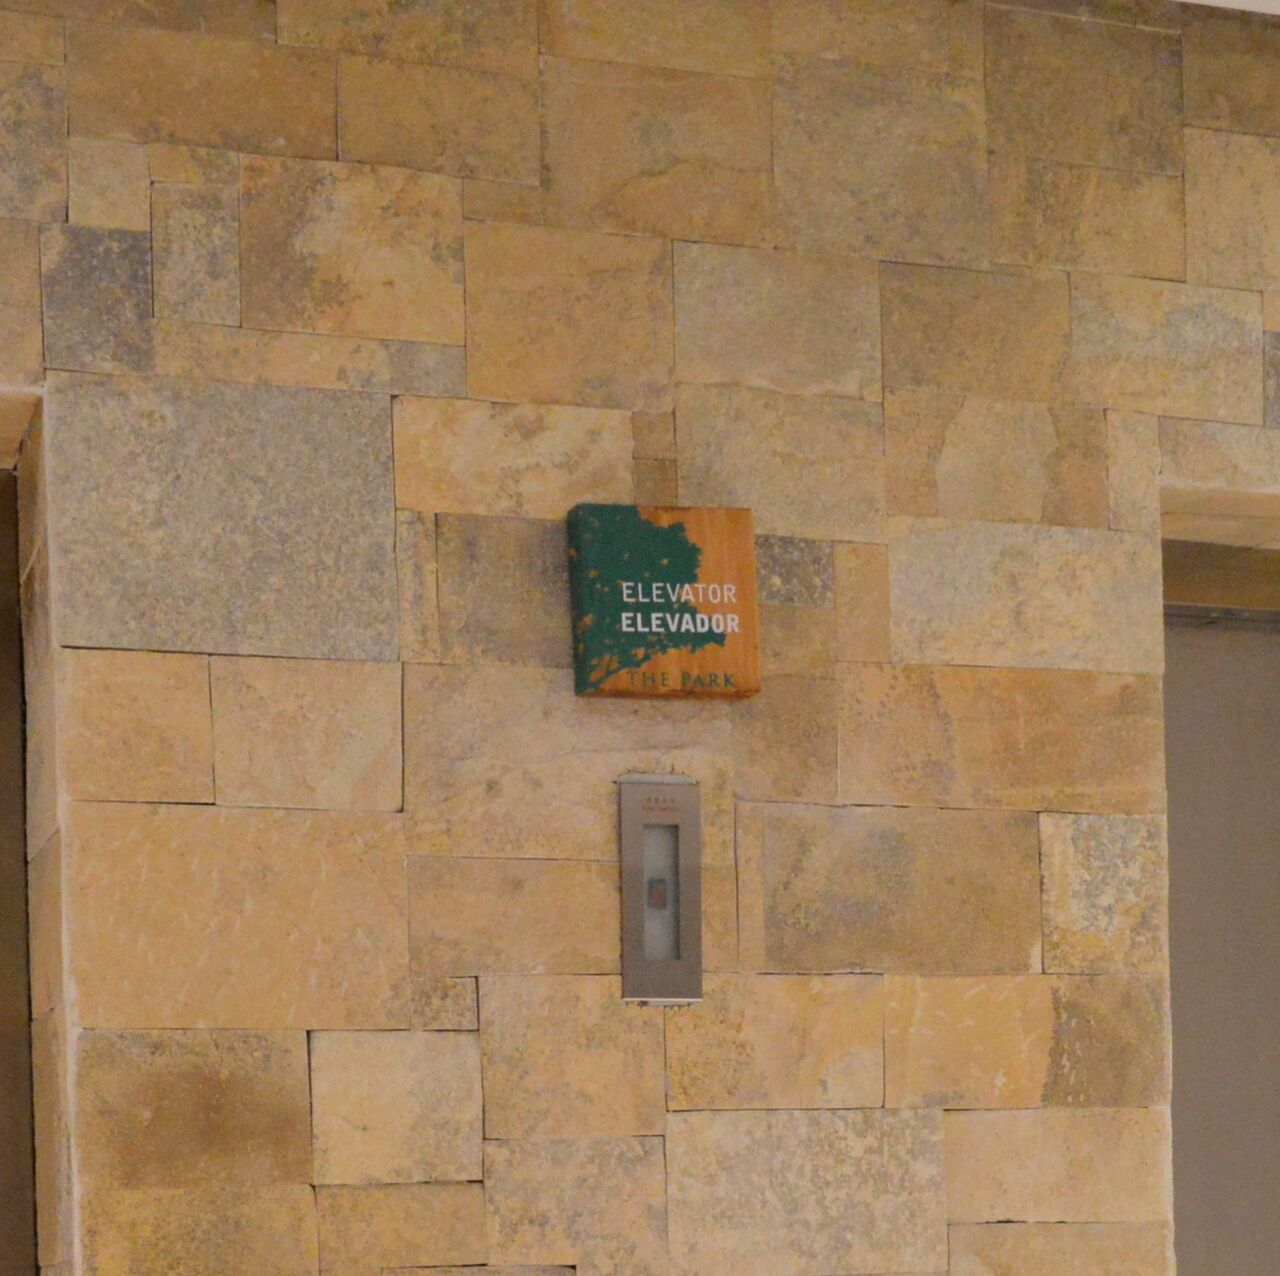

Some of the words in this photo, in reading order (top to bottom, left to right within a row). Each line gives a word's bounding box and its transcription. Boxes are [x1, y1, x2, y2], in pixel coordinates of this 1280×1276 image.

[622, 582, 737, 603] ELEVATOR
[621, 612, 740, 633] ELEVADOR
[628, 671, 669, 688] THE
[681, 671, 737, 688] PARK
